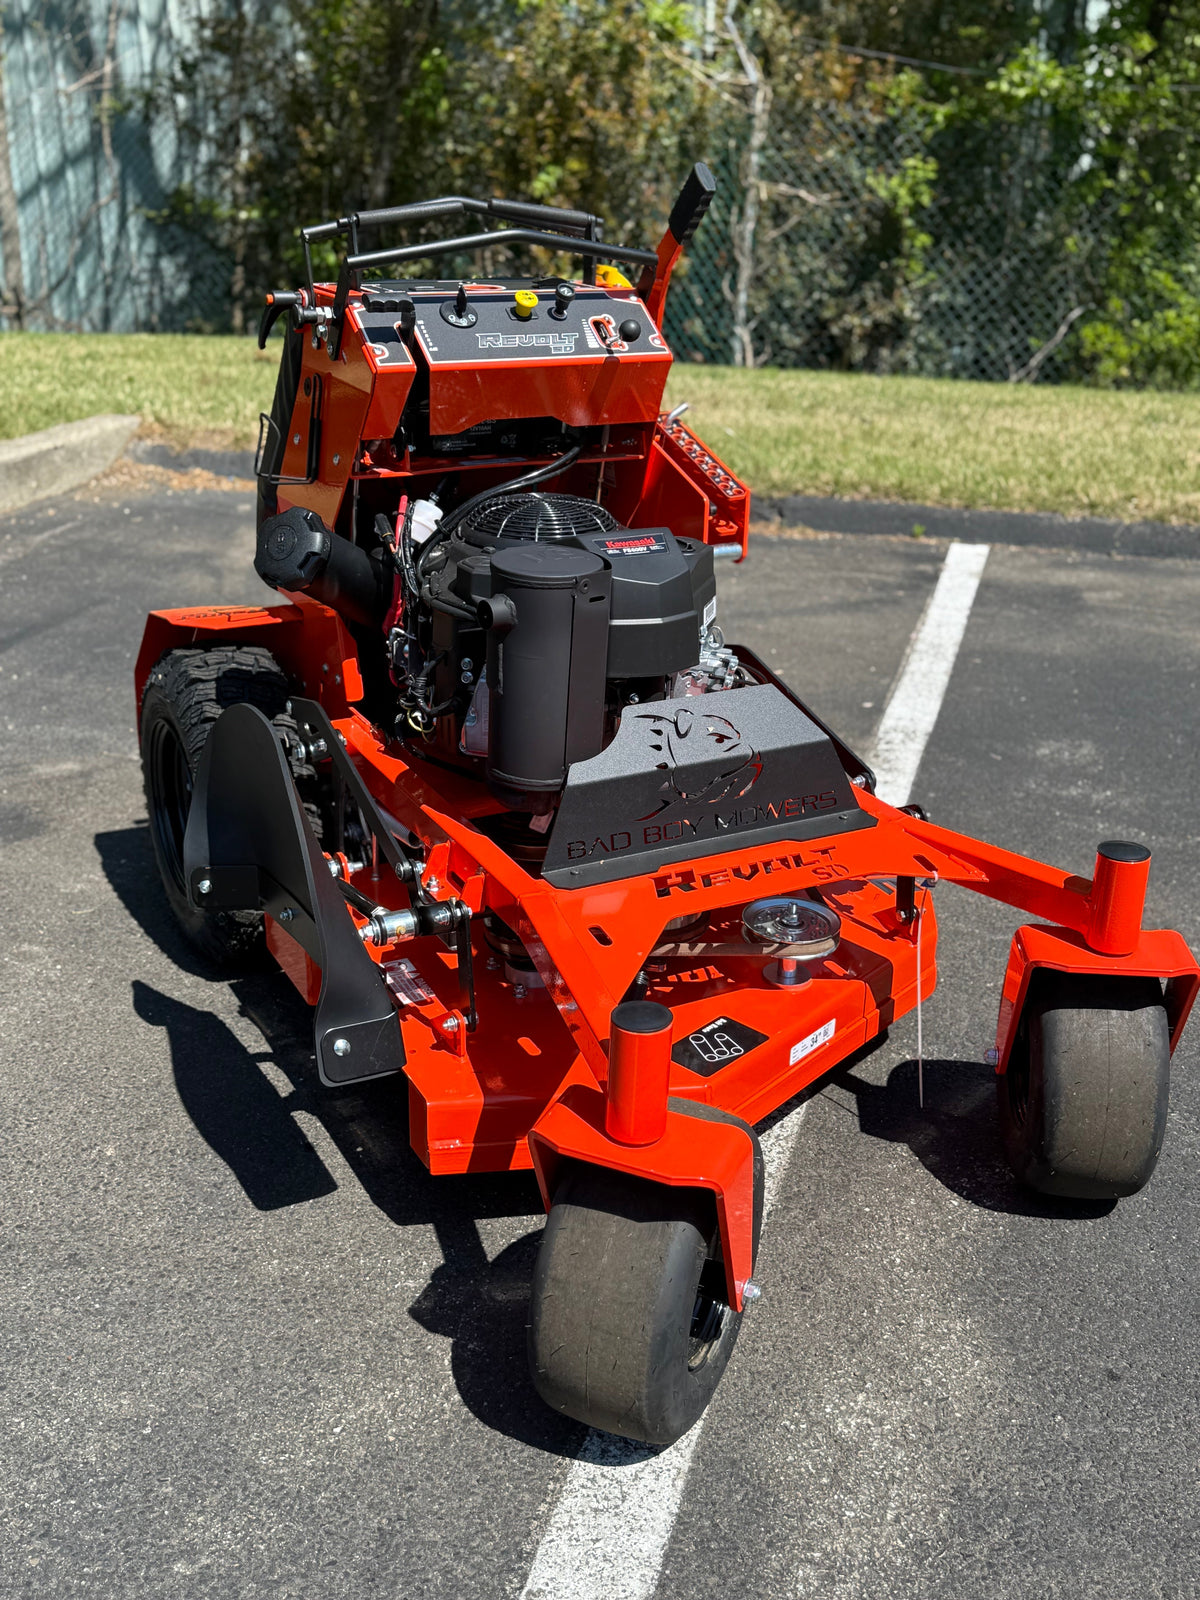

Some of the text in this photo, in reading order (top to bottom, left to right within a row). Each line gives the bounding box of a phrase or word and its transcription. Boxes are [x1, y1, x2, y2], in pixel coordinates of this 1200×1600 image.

[475, 333, 578, 348] REVOLT
[605, 537, 656, 548] Kawasaki
[567, 791, 837, 860] BAD BOY MOWERS
[648, 846, 837, 898] REVOLT
[811, 864, 850, 880] SD
